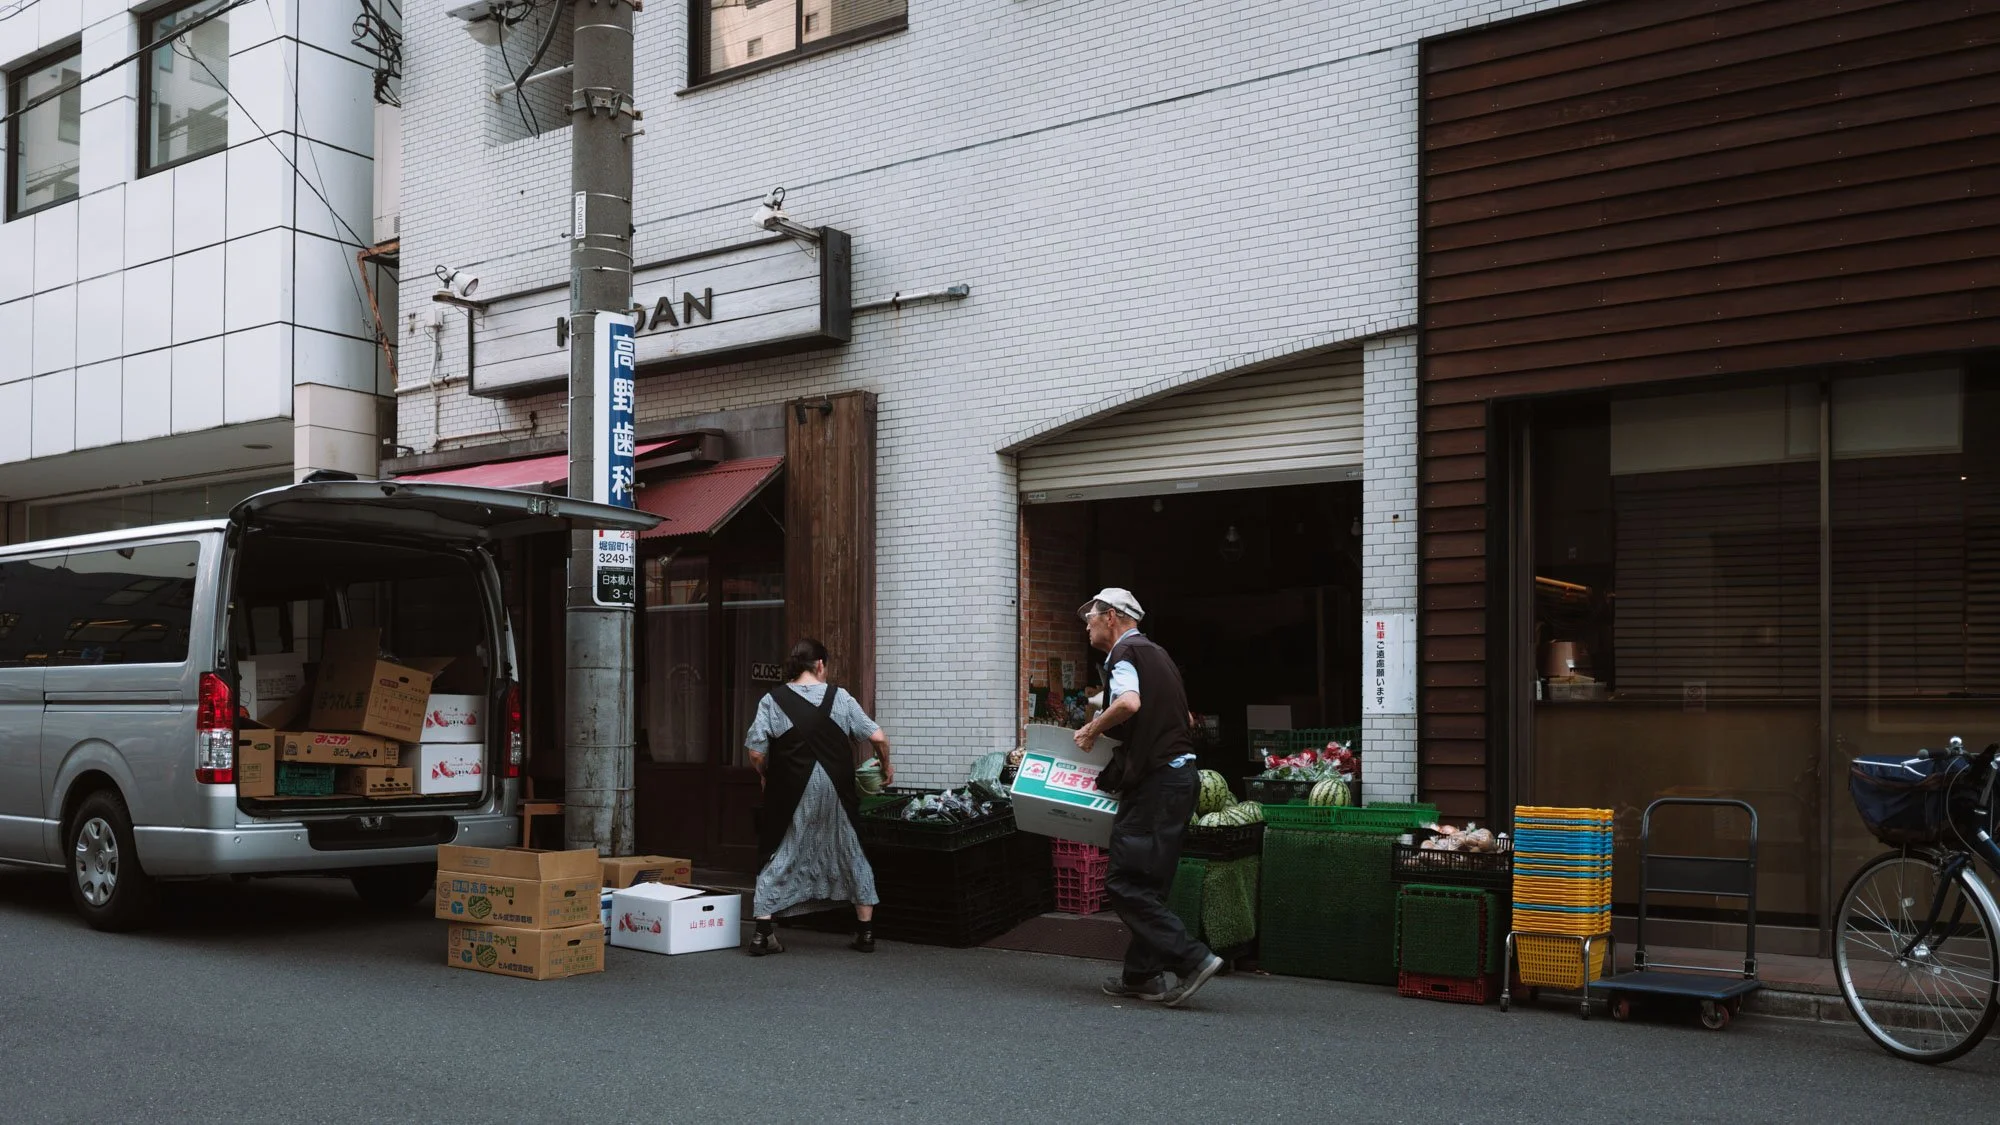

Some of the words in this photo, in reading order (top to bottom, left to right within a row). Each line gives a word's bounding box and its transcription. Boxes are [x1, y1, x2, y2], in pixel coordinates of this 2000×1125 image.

[611, 333, 635, 501] 高野歯科
[752, 664, 781, 679] CLOSE
[690, 918, 724, 930] 山形県産
